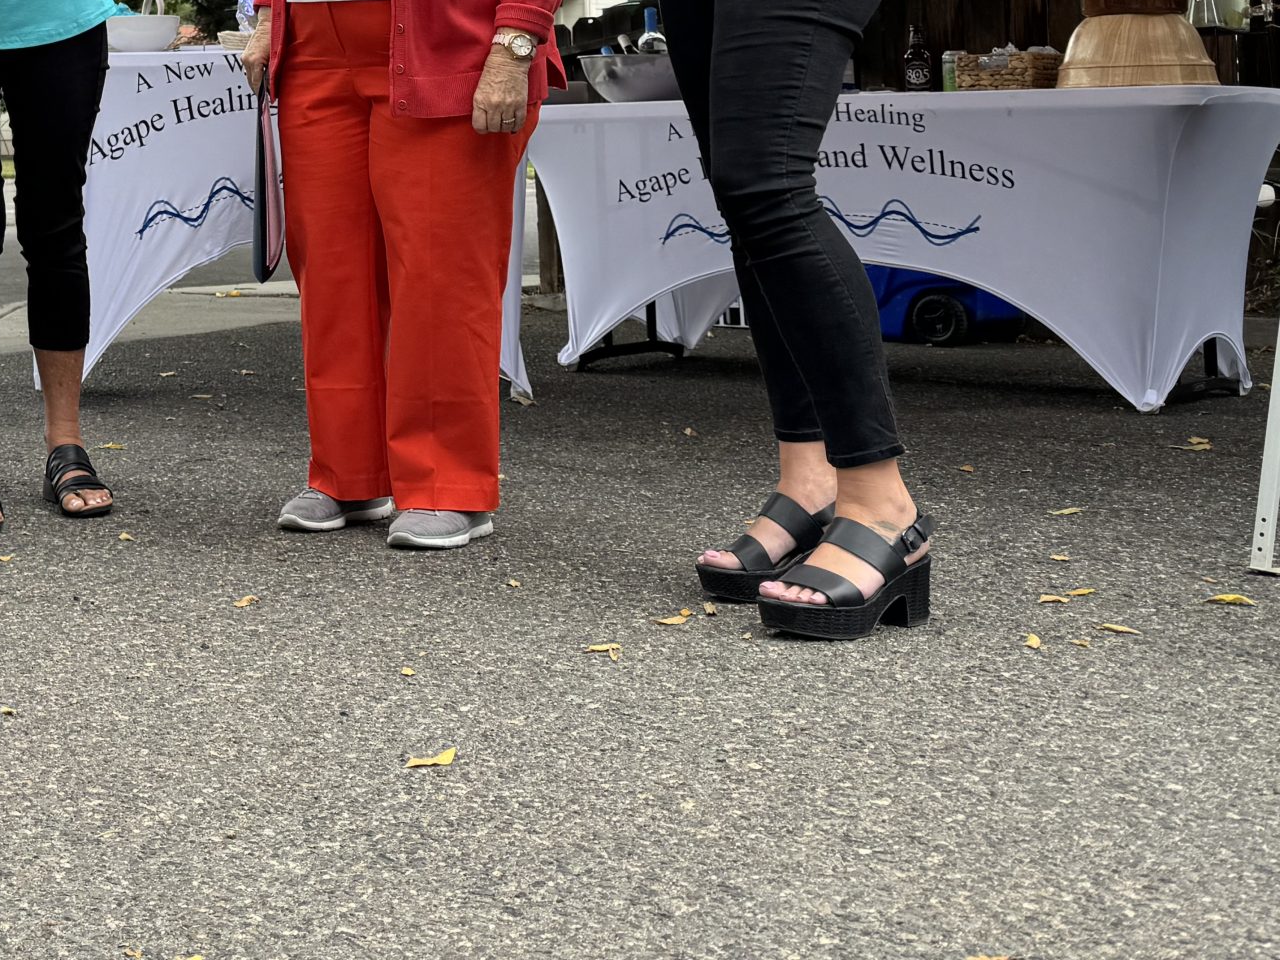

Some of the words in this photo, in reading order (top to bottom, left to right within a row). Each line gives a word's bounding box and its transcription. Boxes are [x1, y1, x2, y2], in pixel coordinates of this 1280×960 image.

[136, 72, 154, 94] A
[163, 61, 215, 84] New
[906, 68, 930, 82] 805
[88, 111, 166, 167] Agape
[667, 122, 685, 141] A
[835, 102, 926, 133] Healing
[617, 167, 691, 203] Agape
[817, 143, 869, 168] and
[877, 144, 1015, 189] Wellness
